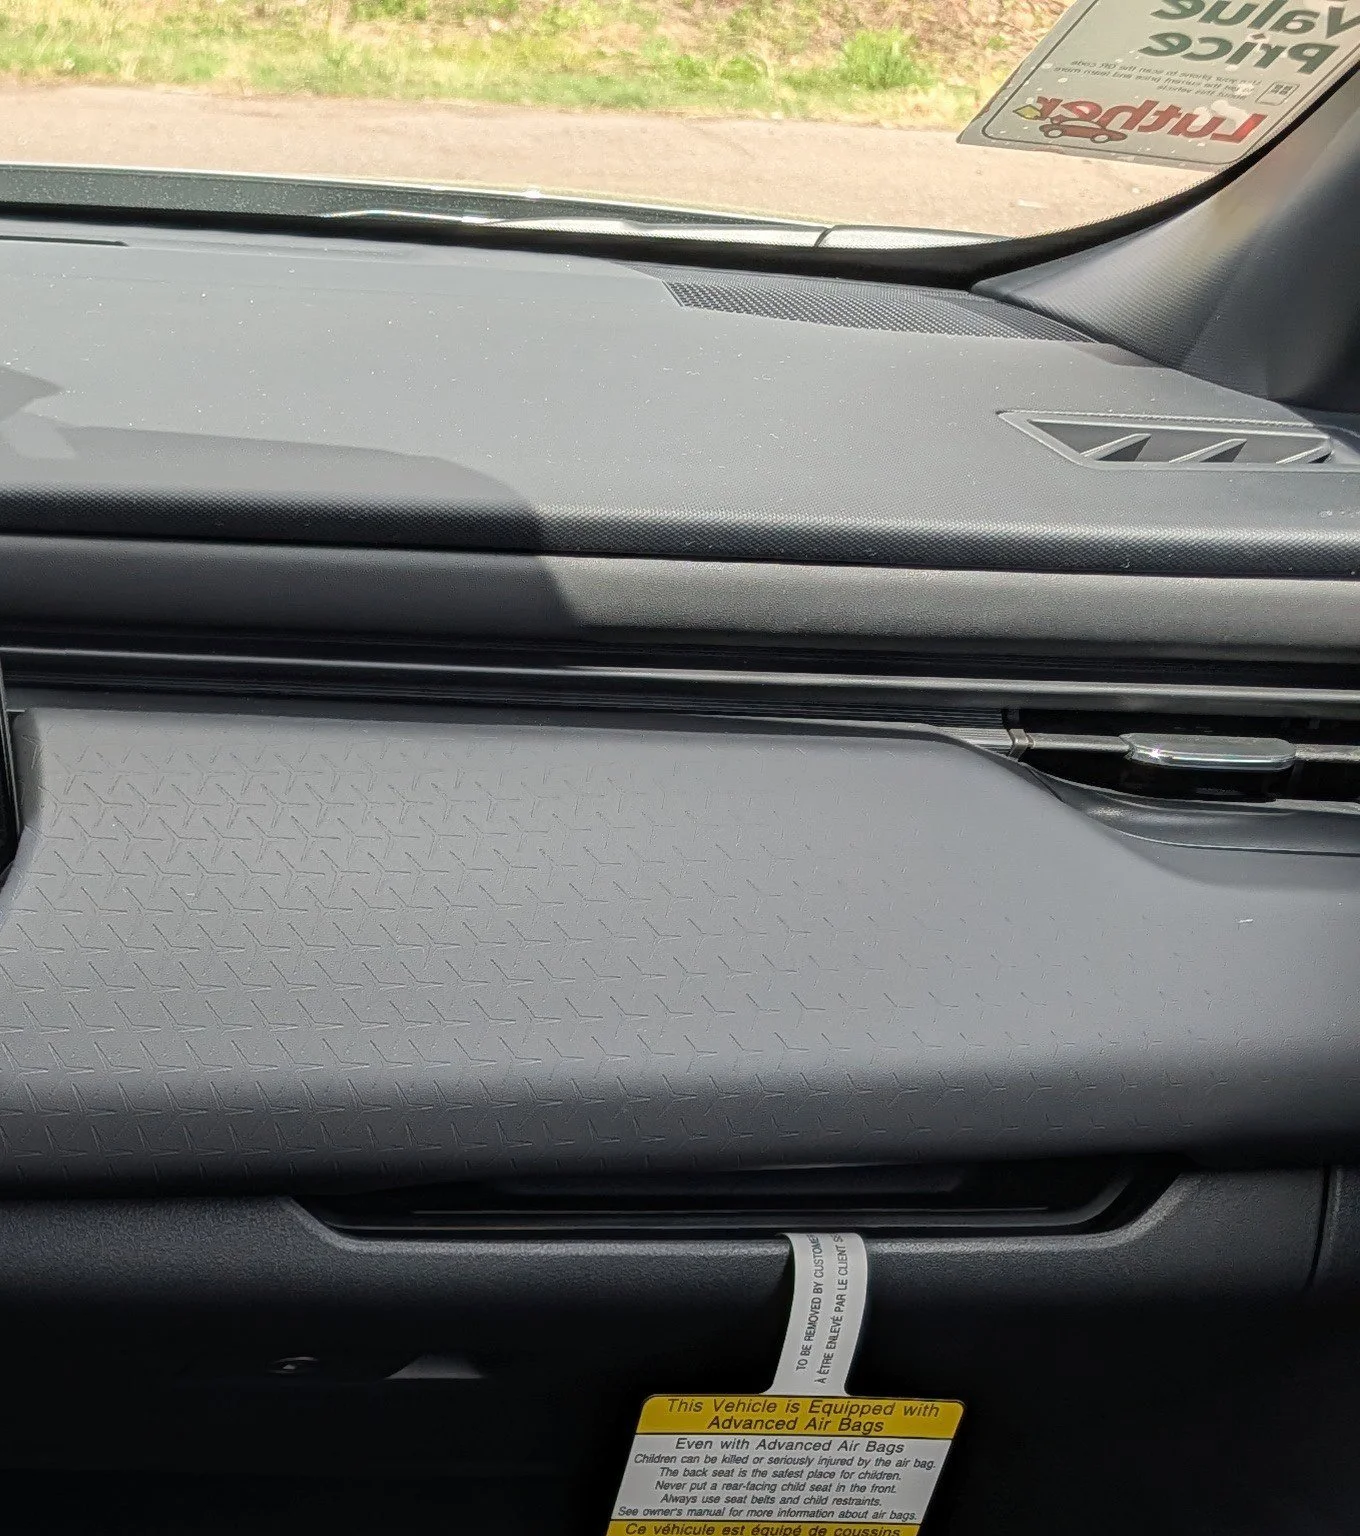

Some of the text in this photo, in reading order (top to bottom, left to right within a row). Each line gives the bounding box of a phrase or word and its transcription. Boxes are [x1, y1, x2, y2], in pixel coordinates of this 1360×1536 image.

[835, 1245, 848, 1276] CLIENT
[810, 1281, 823, 1294] BY
[836, 1279, 848, 1291] LE
[833, 1294, 846, 1313] PAR
[804, 1297, 821, 1342] REMOVED
[825, 1315, 843, 1350] ENLEVÉ
[801, 1345, 811, 1357] BE
[795, 1359, 808, 1372] TO
[818, 1352, 833, 1375] ÊTRE
[664, 1397, 942, 1419] This Vehicle is Equipped with
[706, 1414, 887, 1435] Advanced Air Bags
[674, 1436, 907, 1455] Even with Advanced Air Bags
[633, 1451, 939, 1470] Children can be killed or seriously injured by the air bag.
[654, 1478, 899, 1494] Never put a rear-facing child seat in the front.
[617, 1504, 919, 1522] See owner's manual for more information about air bags.
[623, 1521, 648, 1534] Ce
[651, 1521, 718, 1535] véhicule
[720, 1522, 744, 1535] est
[806, 1524, 830, 1536] de
[832, 1524, 903, 1536] coussins
